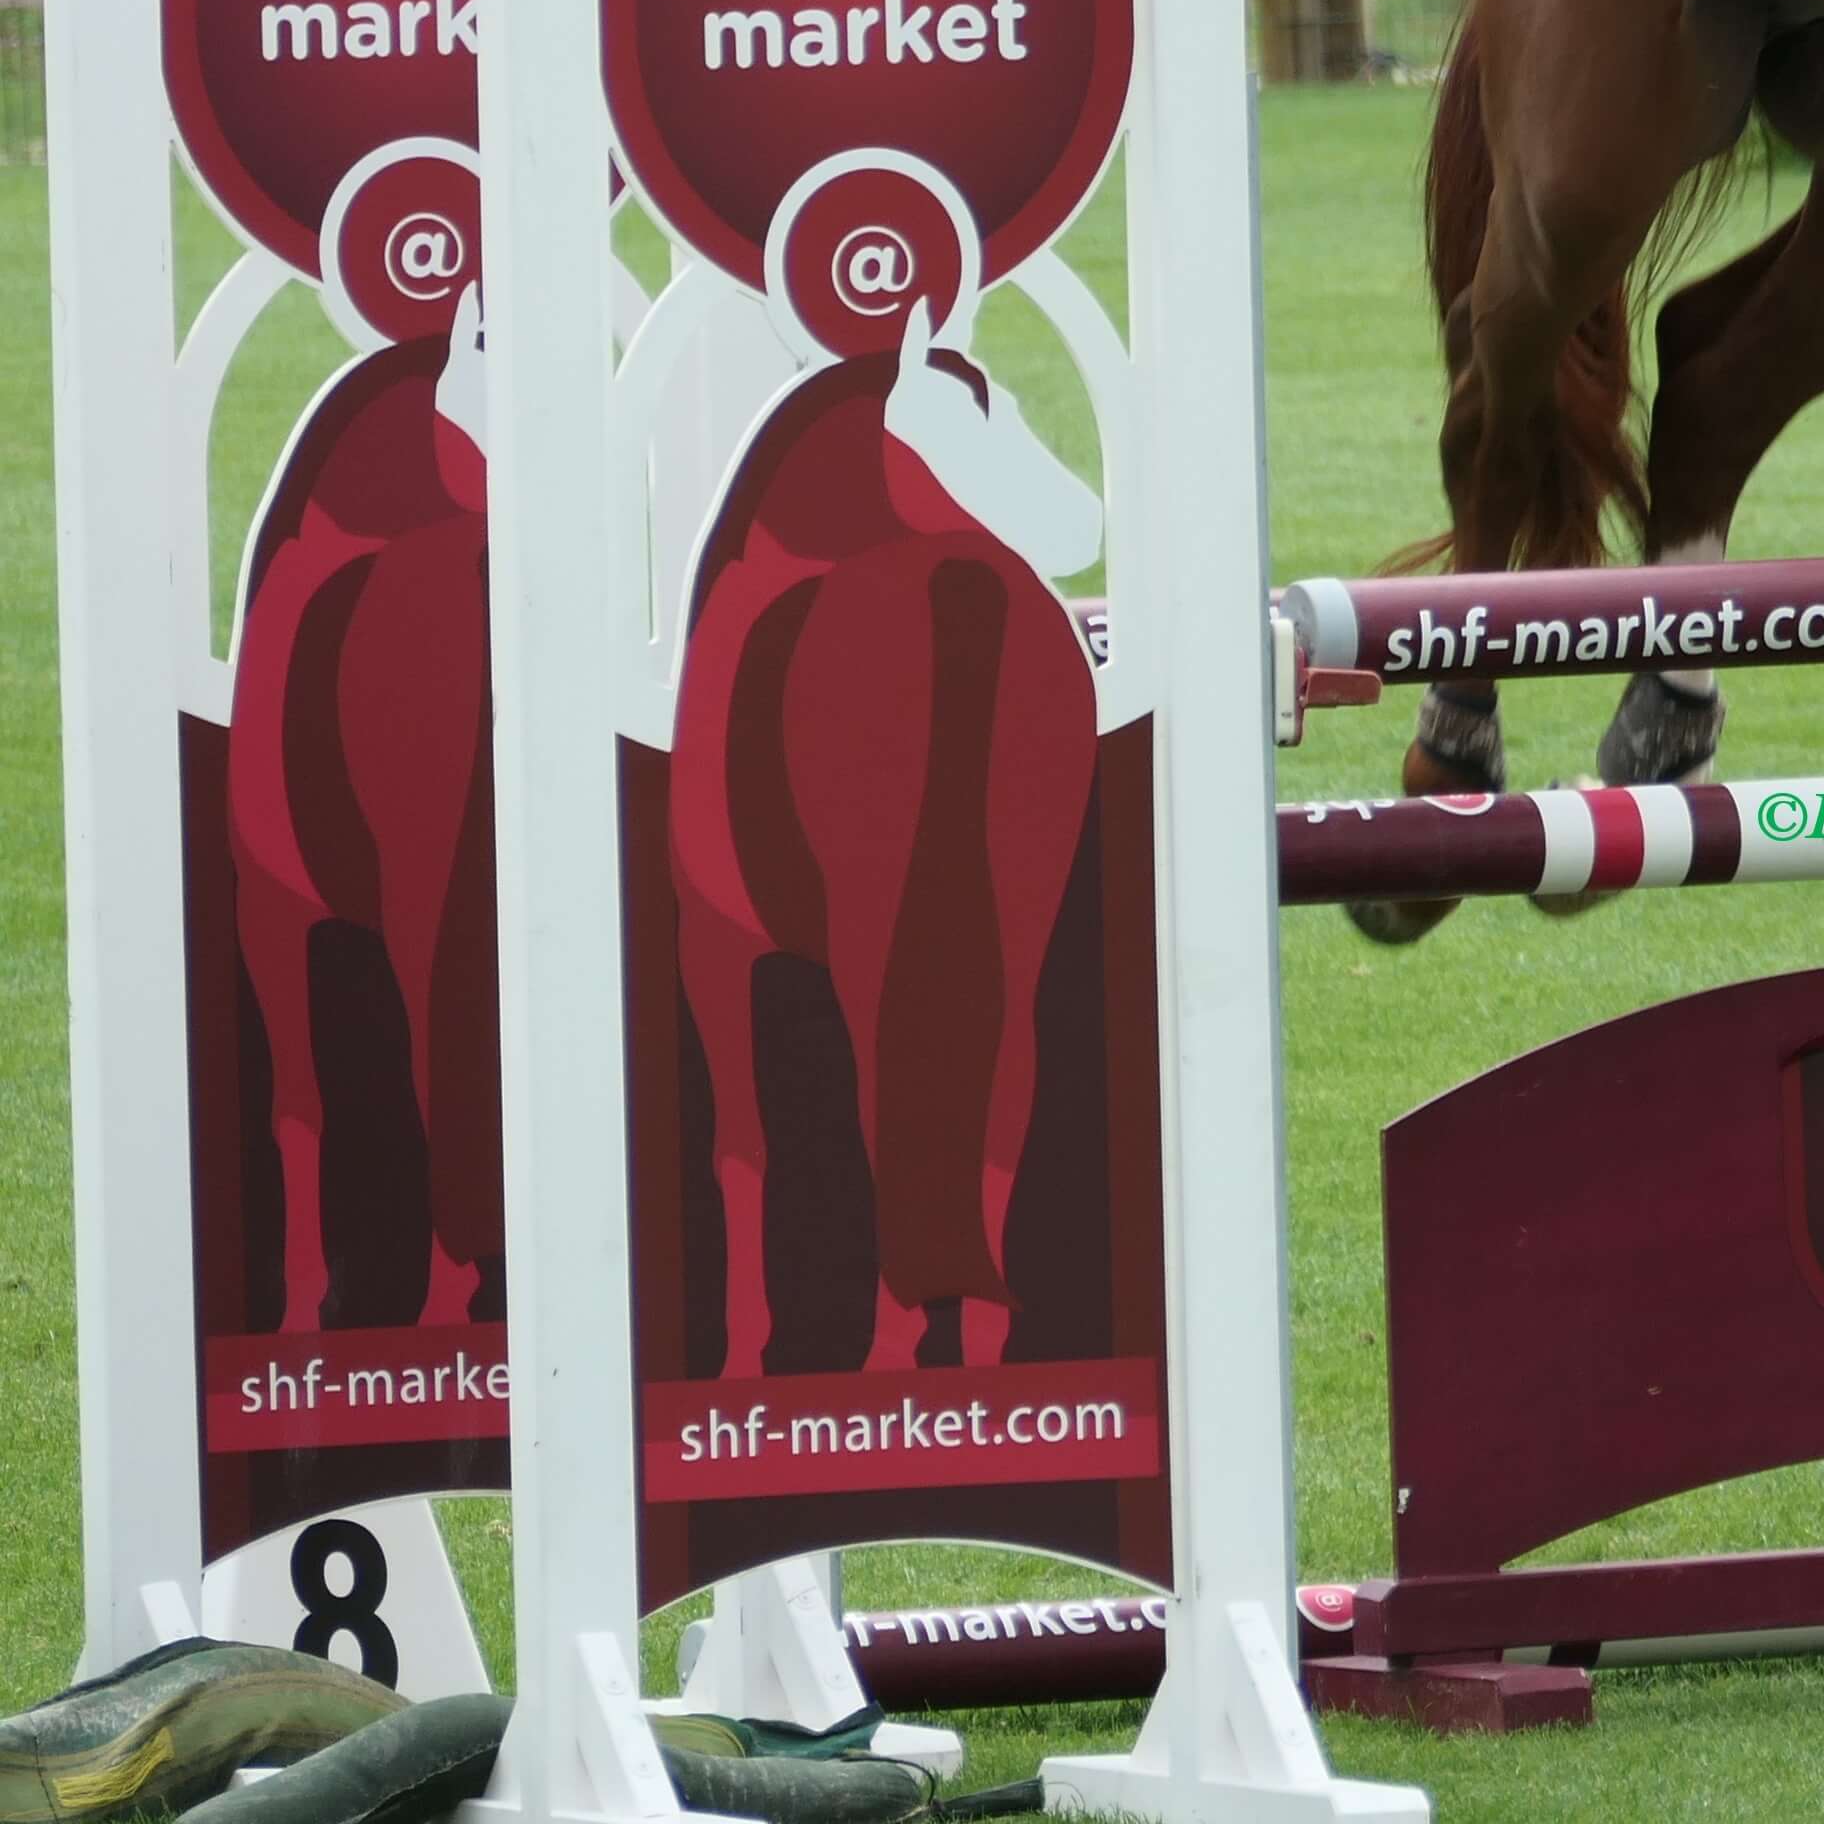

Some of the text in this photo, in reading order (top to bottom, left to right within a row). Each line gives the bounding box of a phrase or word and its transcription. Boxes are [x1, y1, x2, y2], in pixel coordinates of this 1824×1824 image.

[384, 212, 465, 300] @
[831, 225, 917, 317] @
[241, 1351, 510, 1413] shf-marke
[680, 1397, 1124, 1462] shf-market.com
[291, 1518, 398, 1692] 8
